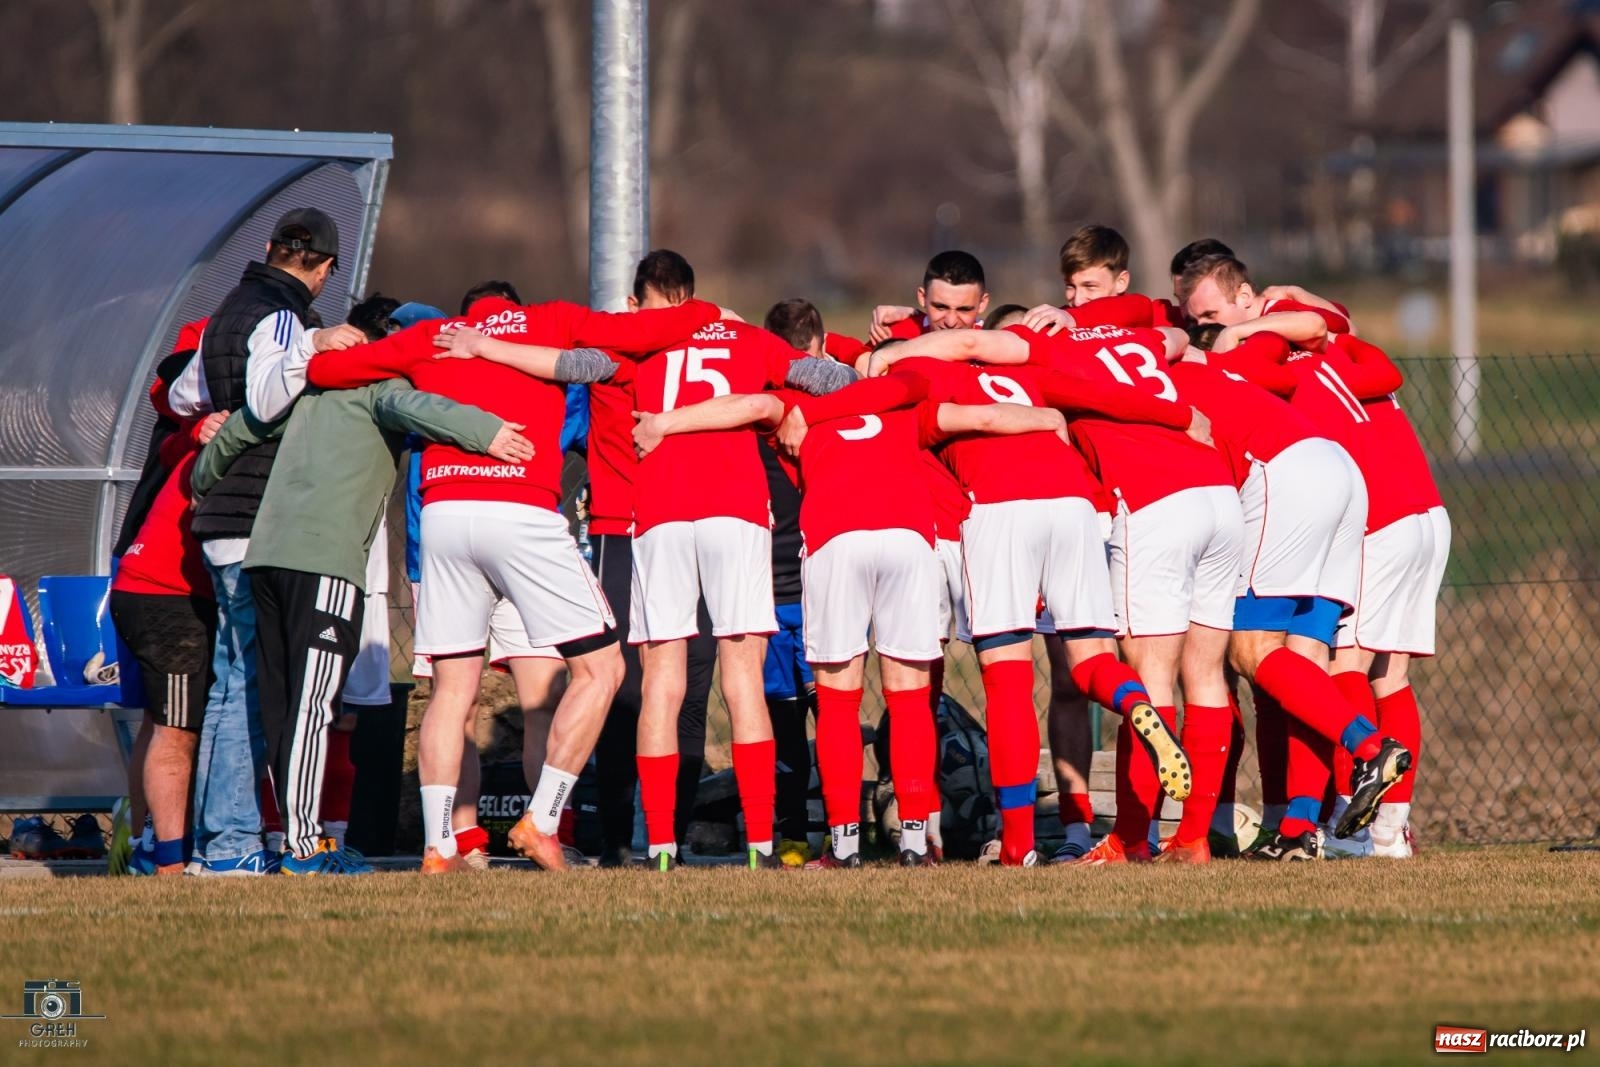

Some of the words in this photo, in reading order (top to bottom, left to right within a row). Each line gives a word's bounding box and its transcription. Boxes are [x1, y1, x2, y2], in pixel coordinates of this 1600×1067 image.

[662, 346, 731, 413] 15
[1094, 342, 1178, 403] 13
[425, 464, 527, 480] ELEKTROWSKAZ
[478, 795, 532, 817] SELECT
